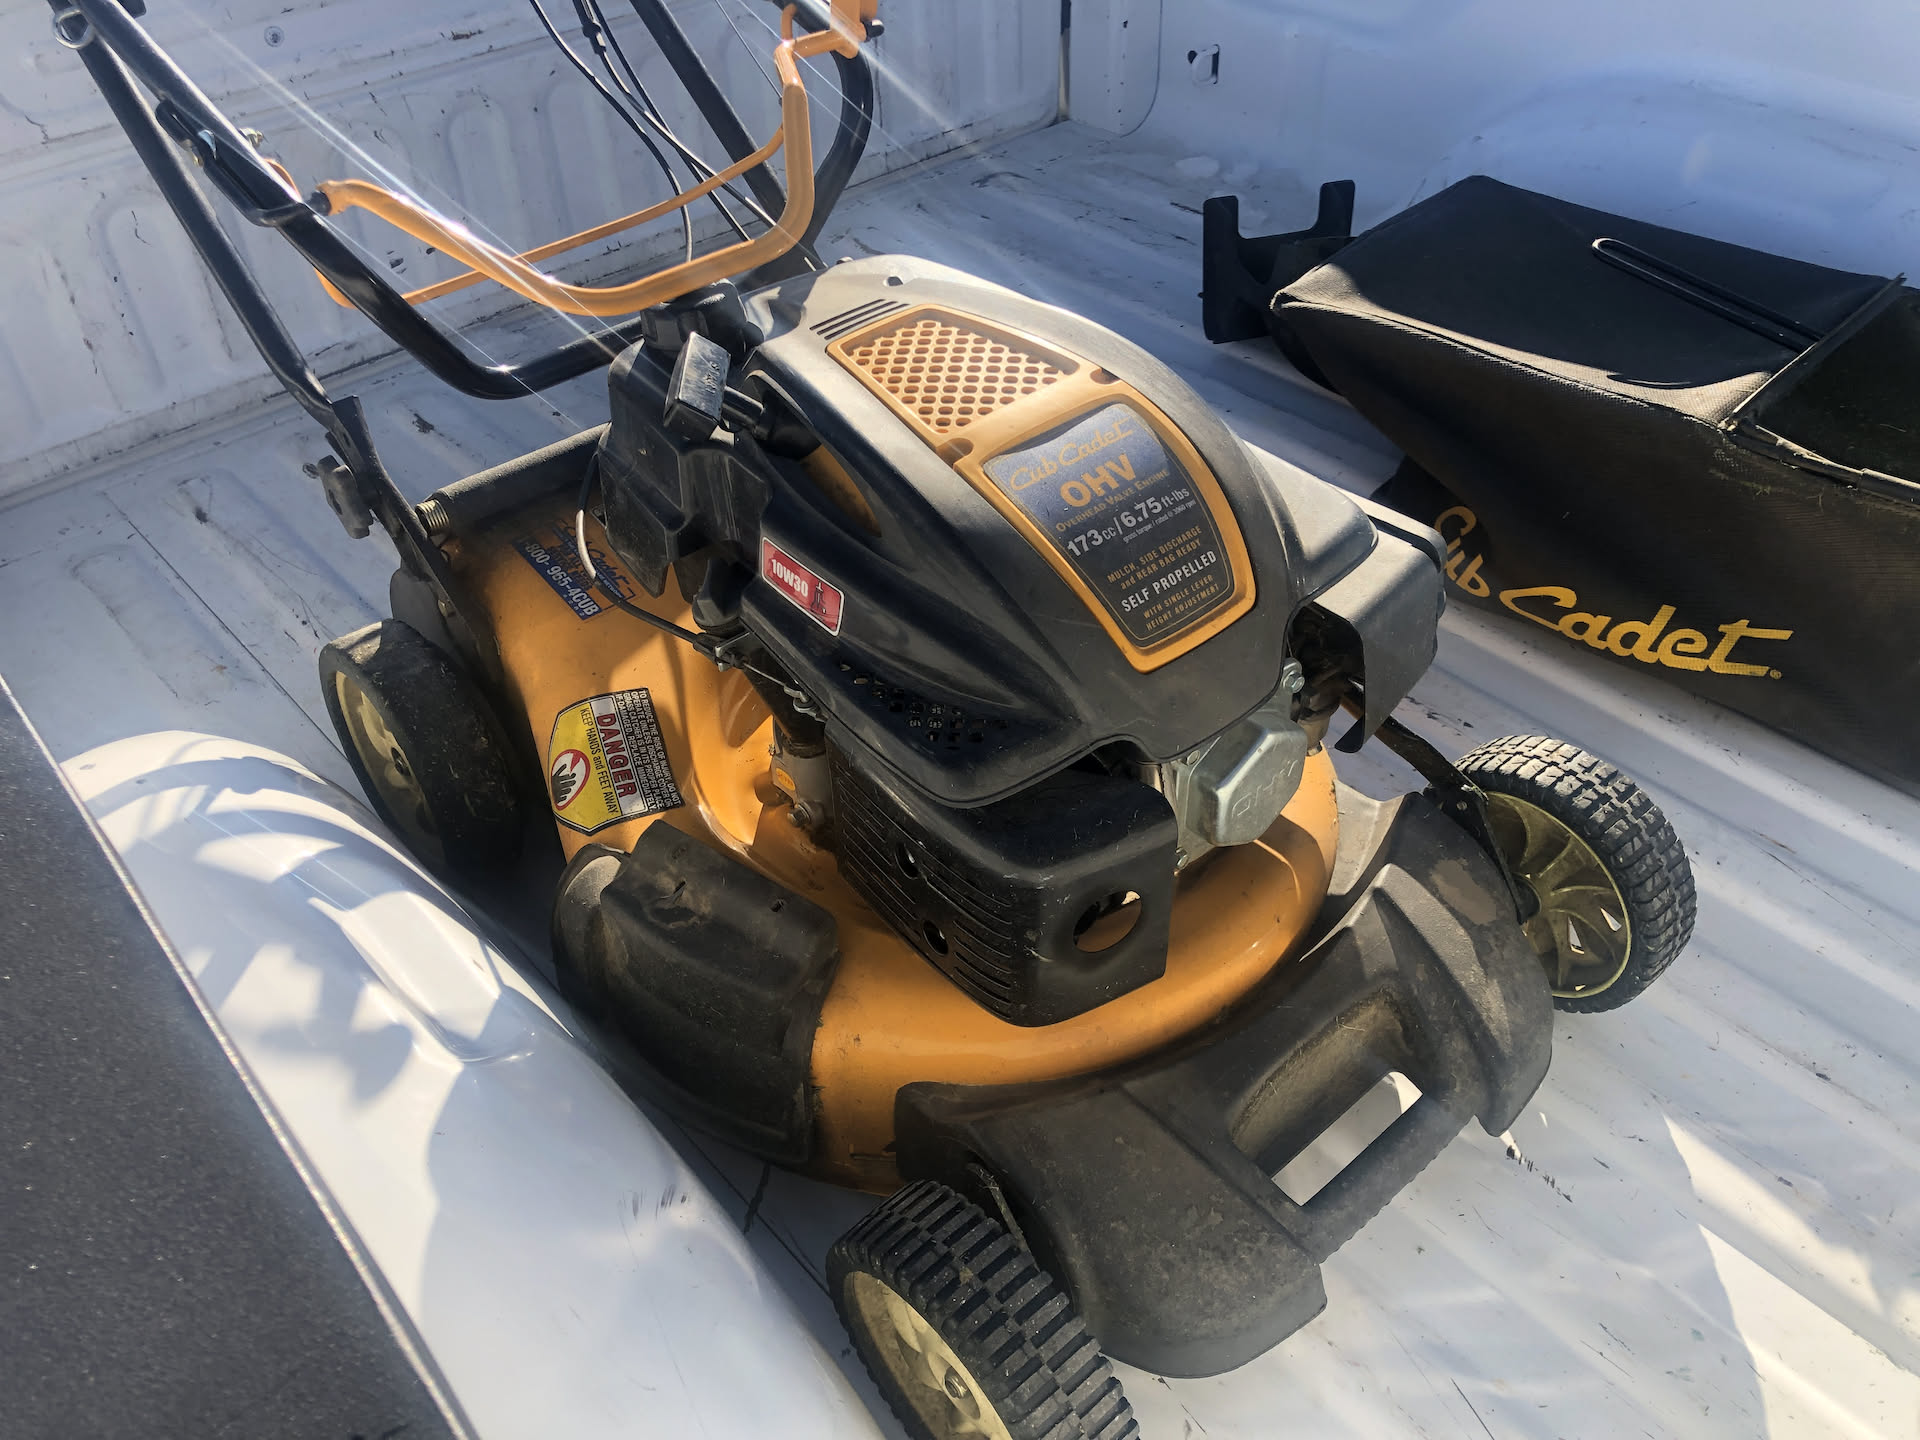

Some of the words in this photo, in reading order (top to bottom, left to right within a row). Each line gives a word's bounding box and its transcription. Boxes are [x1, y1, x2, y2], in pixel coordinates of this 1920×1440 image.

[1010, 457, 1058, 491] Cub
[1058, 417, 1133, 466] Cadet
[1060, 454, 1135, 507] OHV
[1106, 487, 1132, 504] VALVE
[1139, 550, 1159, 565] SIDE
[1158, 526, 1202, 554] DISCHARGE
[771, 558, 808, 598] 10W30
[1120, 576, 1136, 590] and
[1136, 563, 1158, 580] REAR
[1158, 554, 1176, 568] BAG
[1176, 538, 1201, 558] READY
[546, 566, 599, 615] 965-4CUB
[1121, 588, 1149, 612] SELF
[1152, 551, 1216, 594] PROPELLED
[1144, 603, 1163, 618] WITH
[1164, 588, 1190, 607] SINGLE
[1190, 574, 1213, 592] LEVER
[1146, 610, 1172, 631] HEIGHT
[1174, 583, 1219, 614] ADJUSTMENT
[623, 692, 634, 711] GRASS
[641, 698, 654, 723] REDUCE
[580, 707, 594, 726] KEEP
[628, 711, 643, 739] CATCHER
[649, 723, 658, 736] THE
[586, 727, 601, 755] HANDS
[630, 691, 645, 719] OPERATE
[639, 720, 652, 744] UNLESS
[646, 744, 662, 778] DISCHARGE
[652, 736, 663, 751] RISK
[593, 756, 605, 770] and
[597, 713, 636, 797] DANGER
[627, 735, 642, 766] REPLACE
[597, 770, 611, 790] FEET
[644, 764, 658, 788] PROPER
[603, 792, 618, 813] AWAY
[670, 792, 681, 804] NOT
